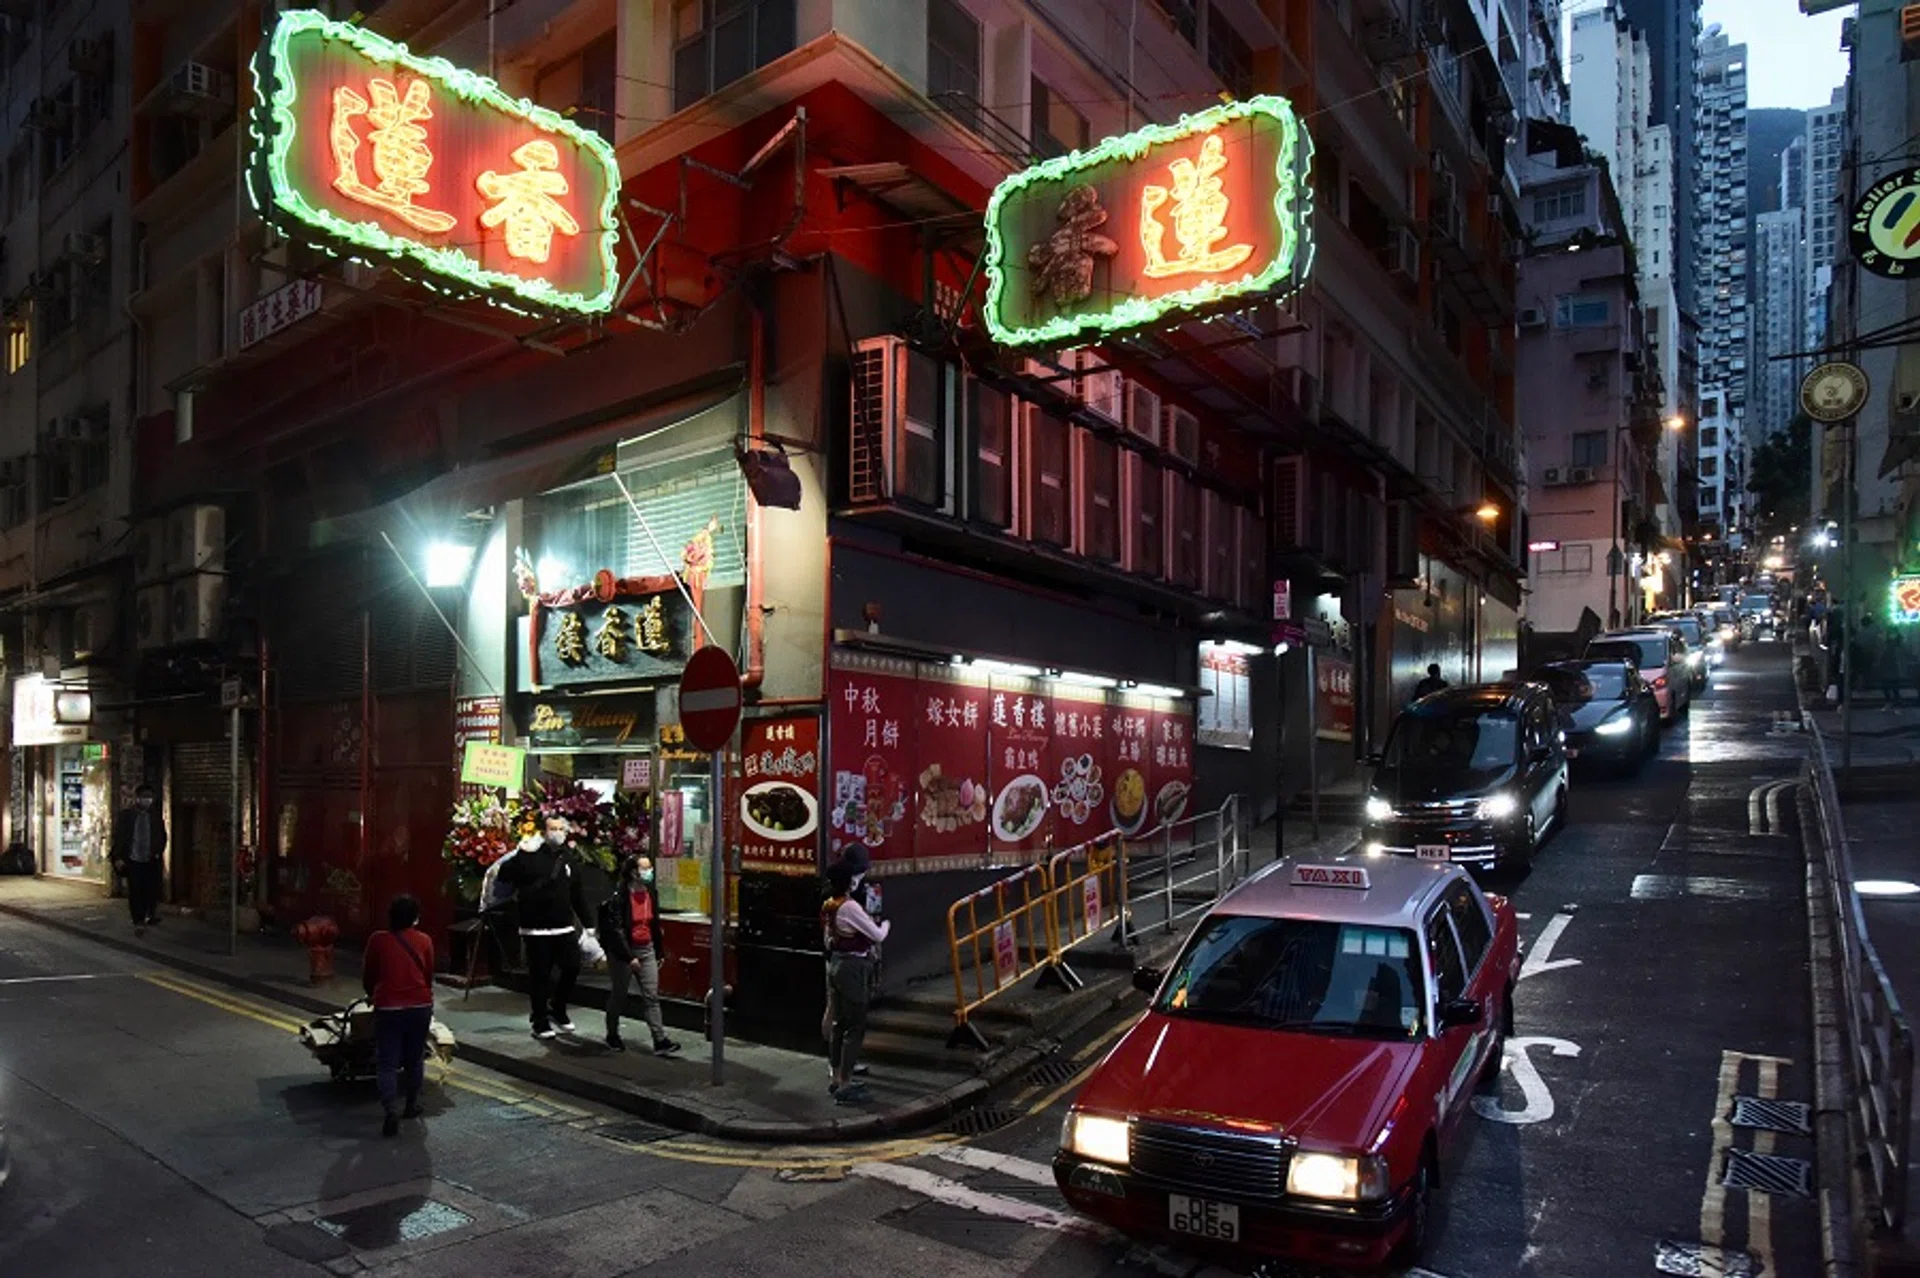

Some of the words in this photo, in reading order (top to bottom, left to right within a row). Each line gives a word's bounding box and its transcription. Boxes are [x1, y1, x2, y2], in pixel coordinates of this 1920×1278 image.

[844, 681, 881, 714] 中秋
[993, 693, 1046, 730] 蓮香樓
[529, 703, 565, 731] Lin
[926, 697, 979, 730] 嫁女餅
[863, 718, 900, 749] 月餅
[1298, 868, 1362, 885] TAXI
[1174, 1213, 1234, 1238] 6069
